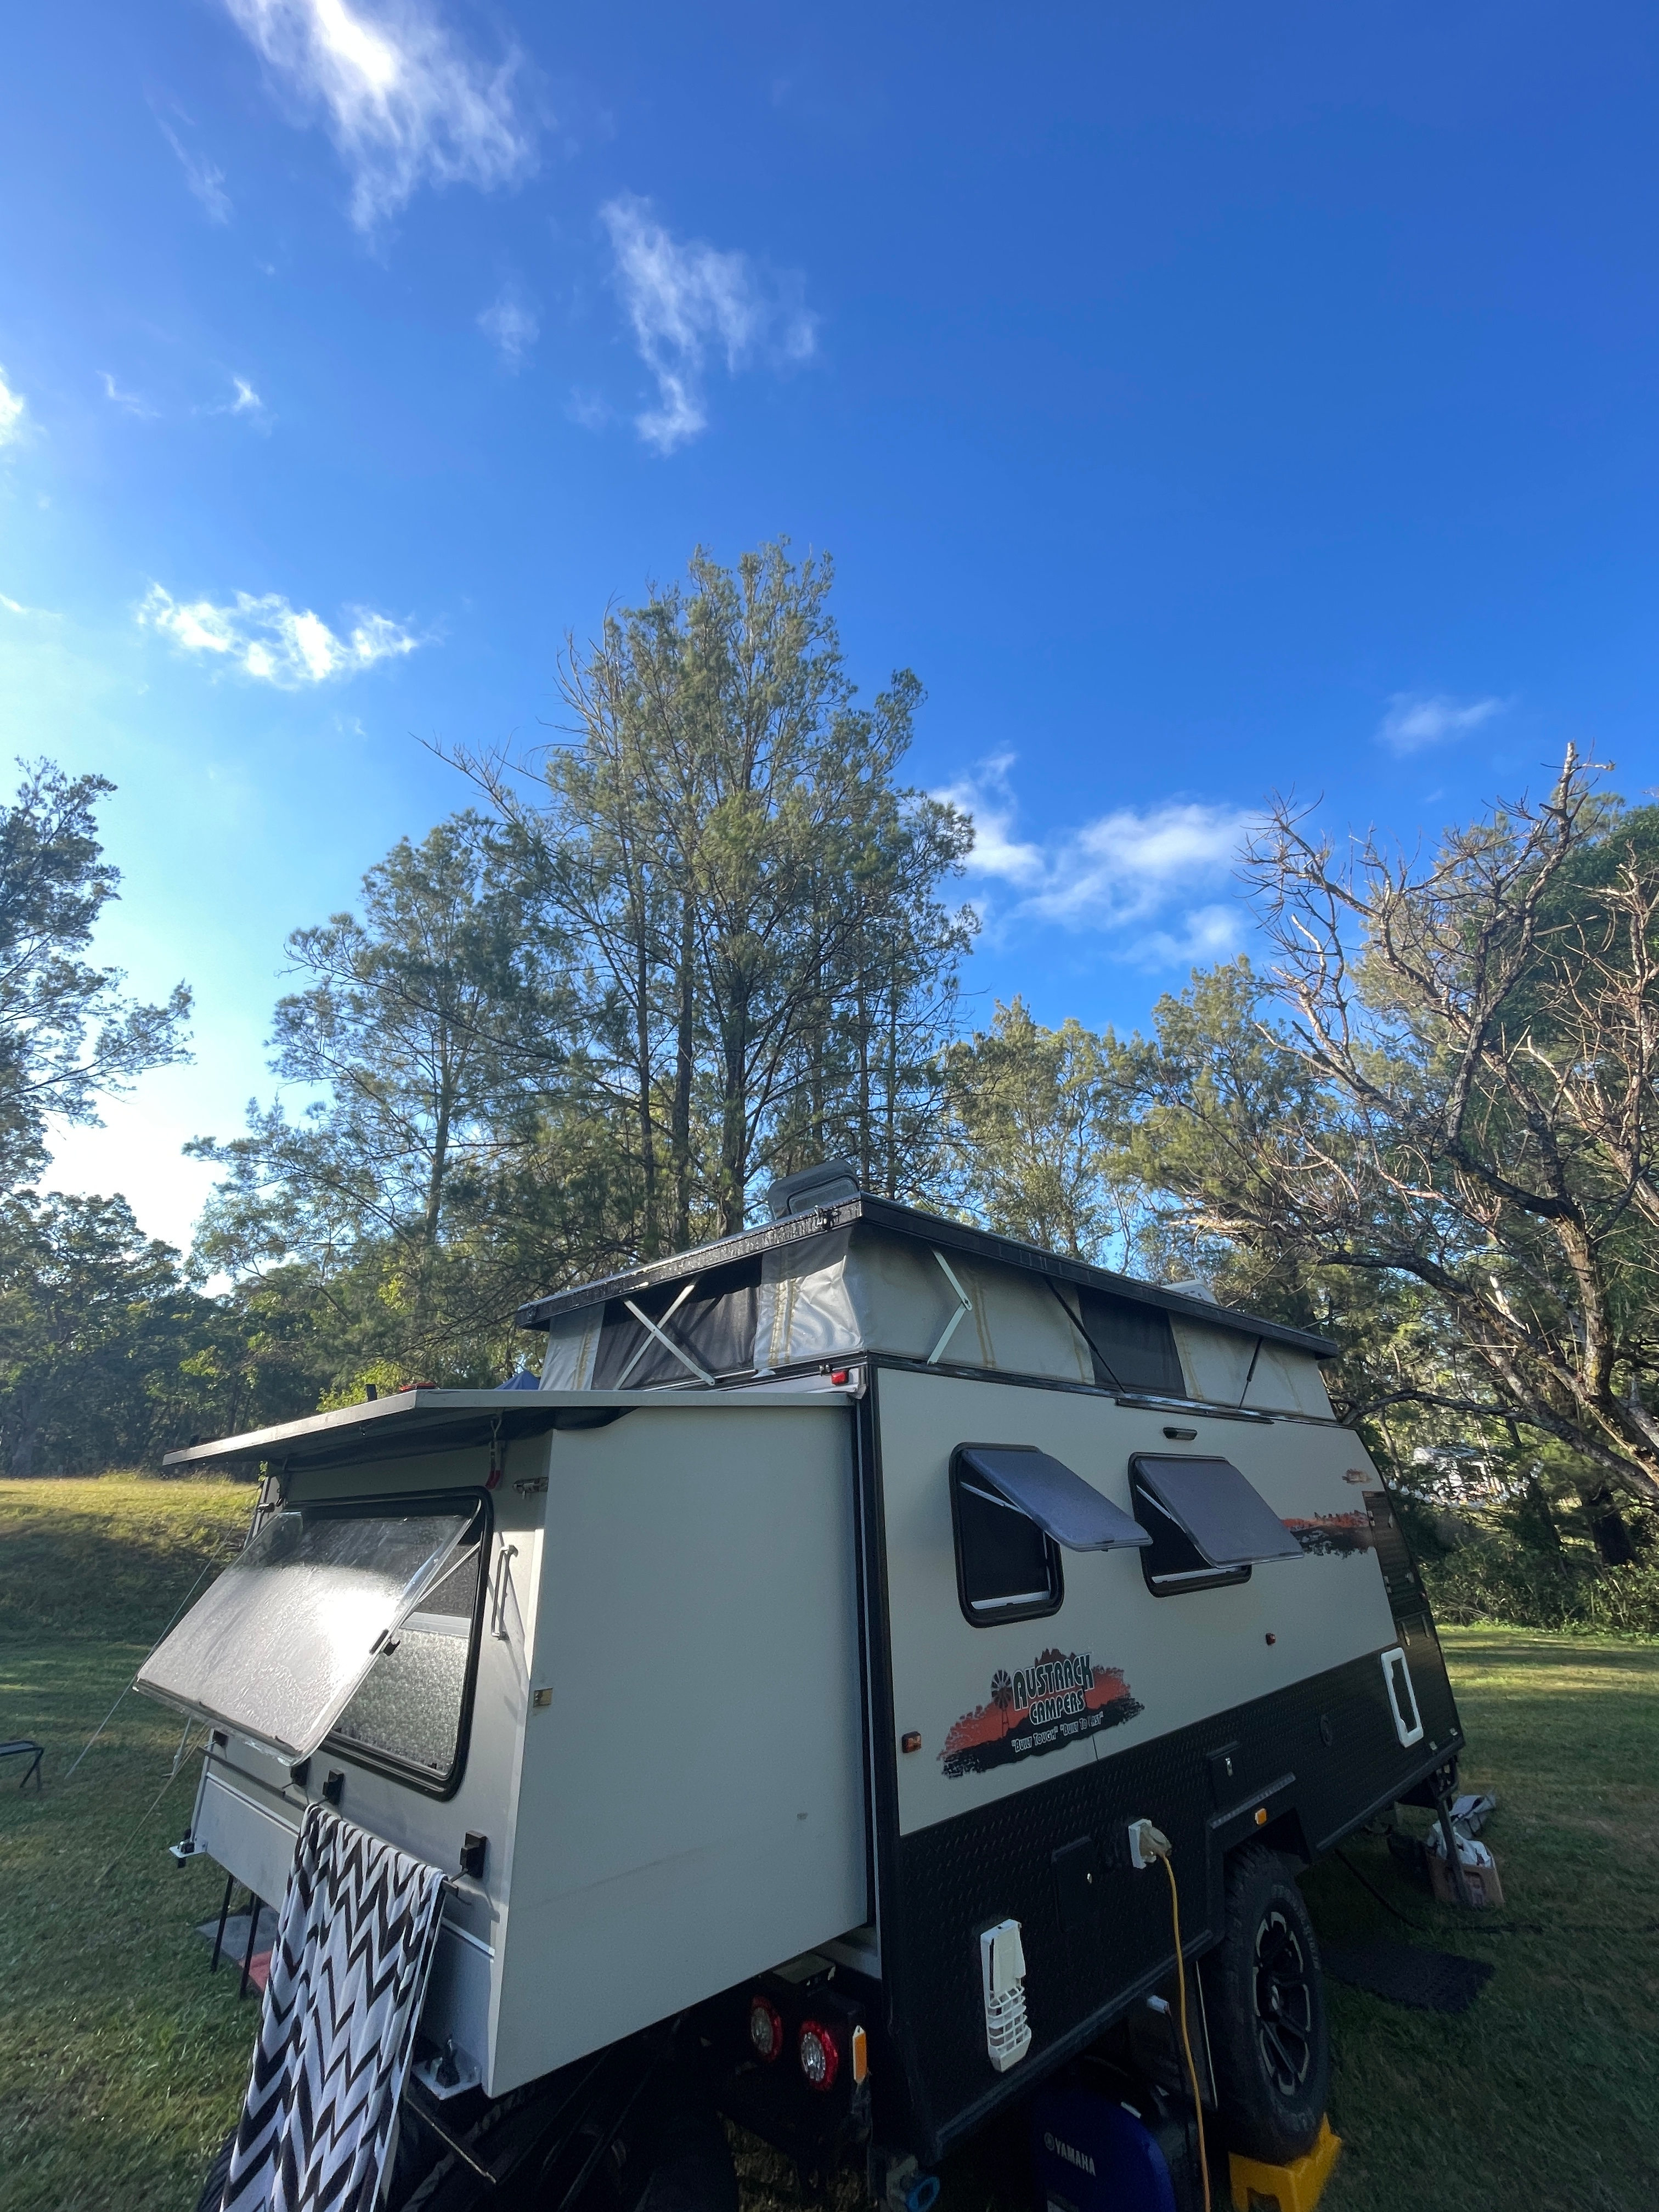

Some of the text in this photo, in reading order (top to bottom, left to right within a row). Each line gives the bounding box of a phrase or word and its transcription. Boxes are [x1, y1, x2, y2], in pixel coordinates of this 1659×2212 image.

[1013, 1654, 1094, 1710] AUSTRACK
[1029, 1689, 1085, 1725] CAMPERS
[1056, 2137, 1096, 2176] YAMAHA
